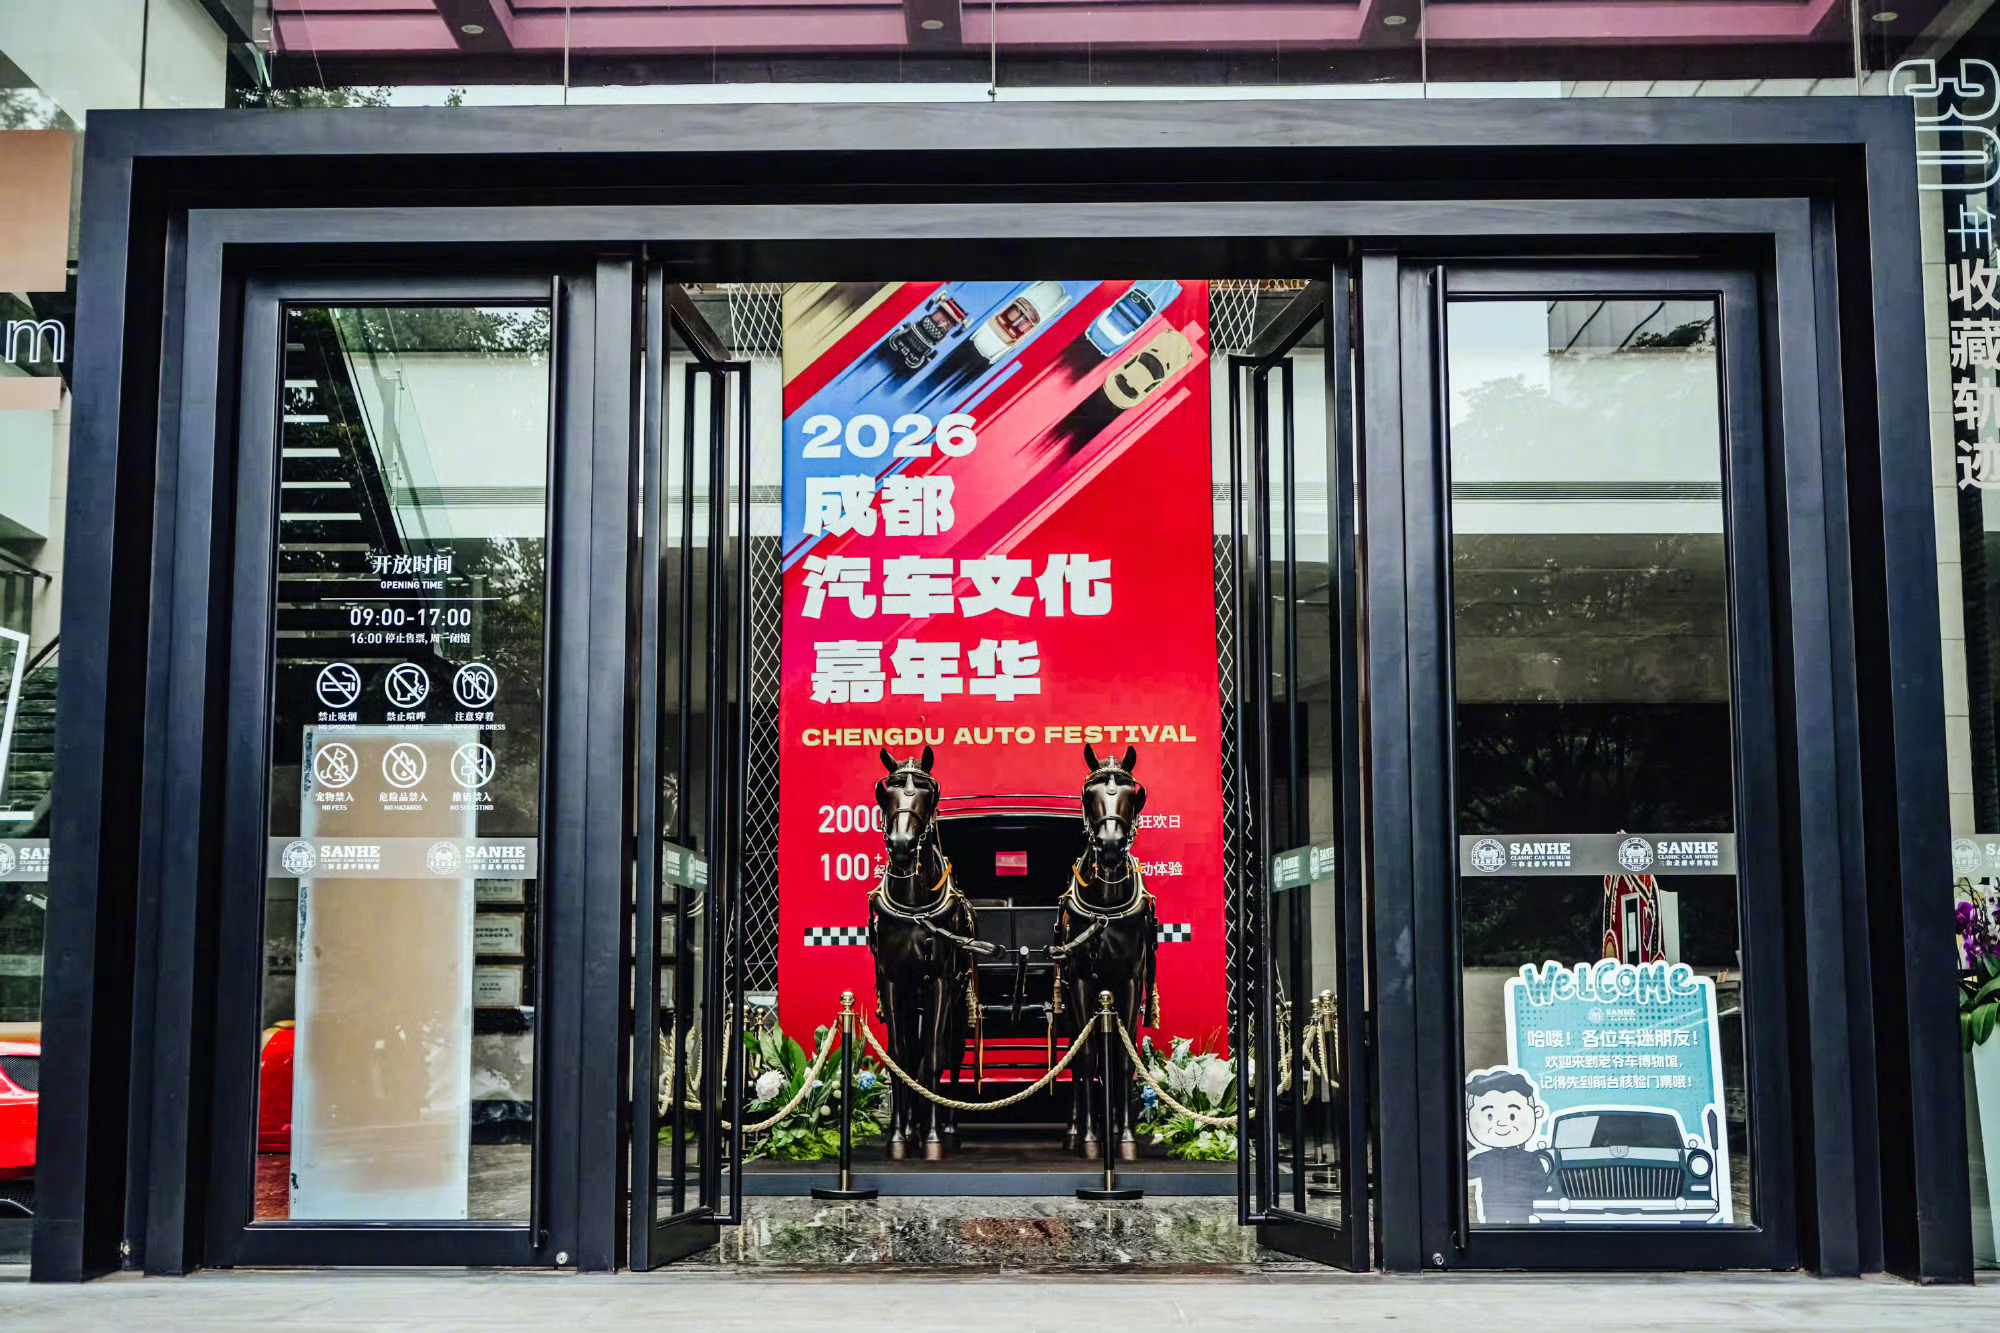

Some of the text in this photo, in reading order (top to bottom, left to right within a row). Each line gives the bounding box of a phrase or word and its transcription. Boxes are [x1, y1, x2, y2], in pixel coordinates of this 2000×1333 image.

[801, 413, 978, 459] 2026
[802, 473, 957, 538] 成都
[371, 554, 453, 575] 开放时间
[380, 580, 444, 590] OPENING TIME
[801, 553, 1114, 619] 汽车文化
[350, 607, 472, 627] 09:00-17:00
[350, 632, 382, 644] 16:00
[809, 637, 1043, 705] 嘉年华
[317, 711, 358, 722] 禁止吸烟
[386, 711, 427, 722] 禁止喧哗
[454, 711, 495, 722] 注意穿着
[801, 725, 1198, 747] CHENGDU AUTO FESTIVAL
[315, 791, 355, 802] 宠物禁入
[378, 791, 429, 802] 危险品禁入
[1138, 814, 1181, 829] 狂欢日
[320, 845, 381, 858] SANHE
[465, 846, 526, 858] SANHE
[1510, 842, 1571, 856] SANHE
[1657, 841, 1719, 854] SANHE
